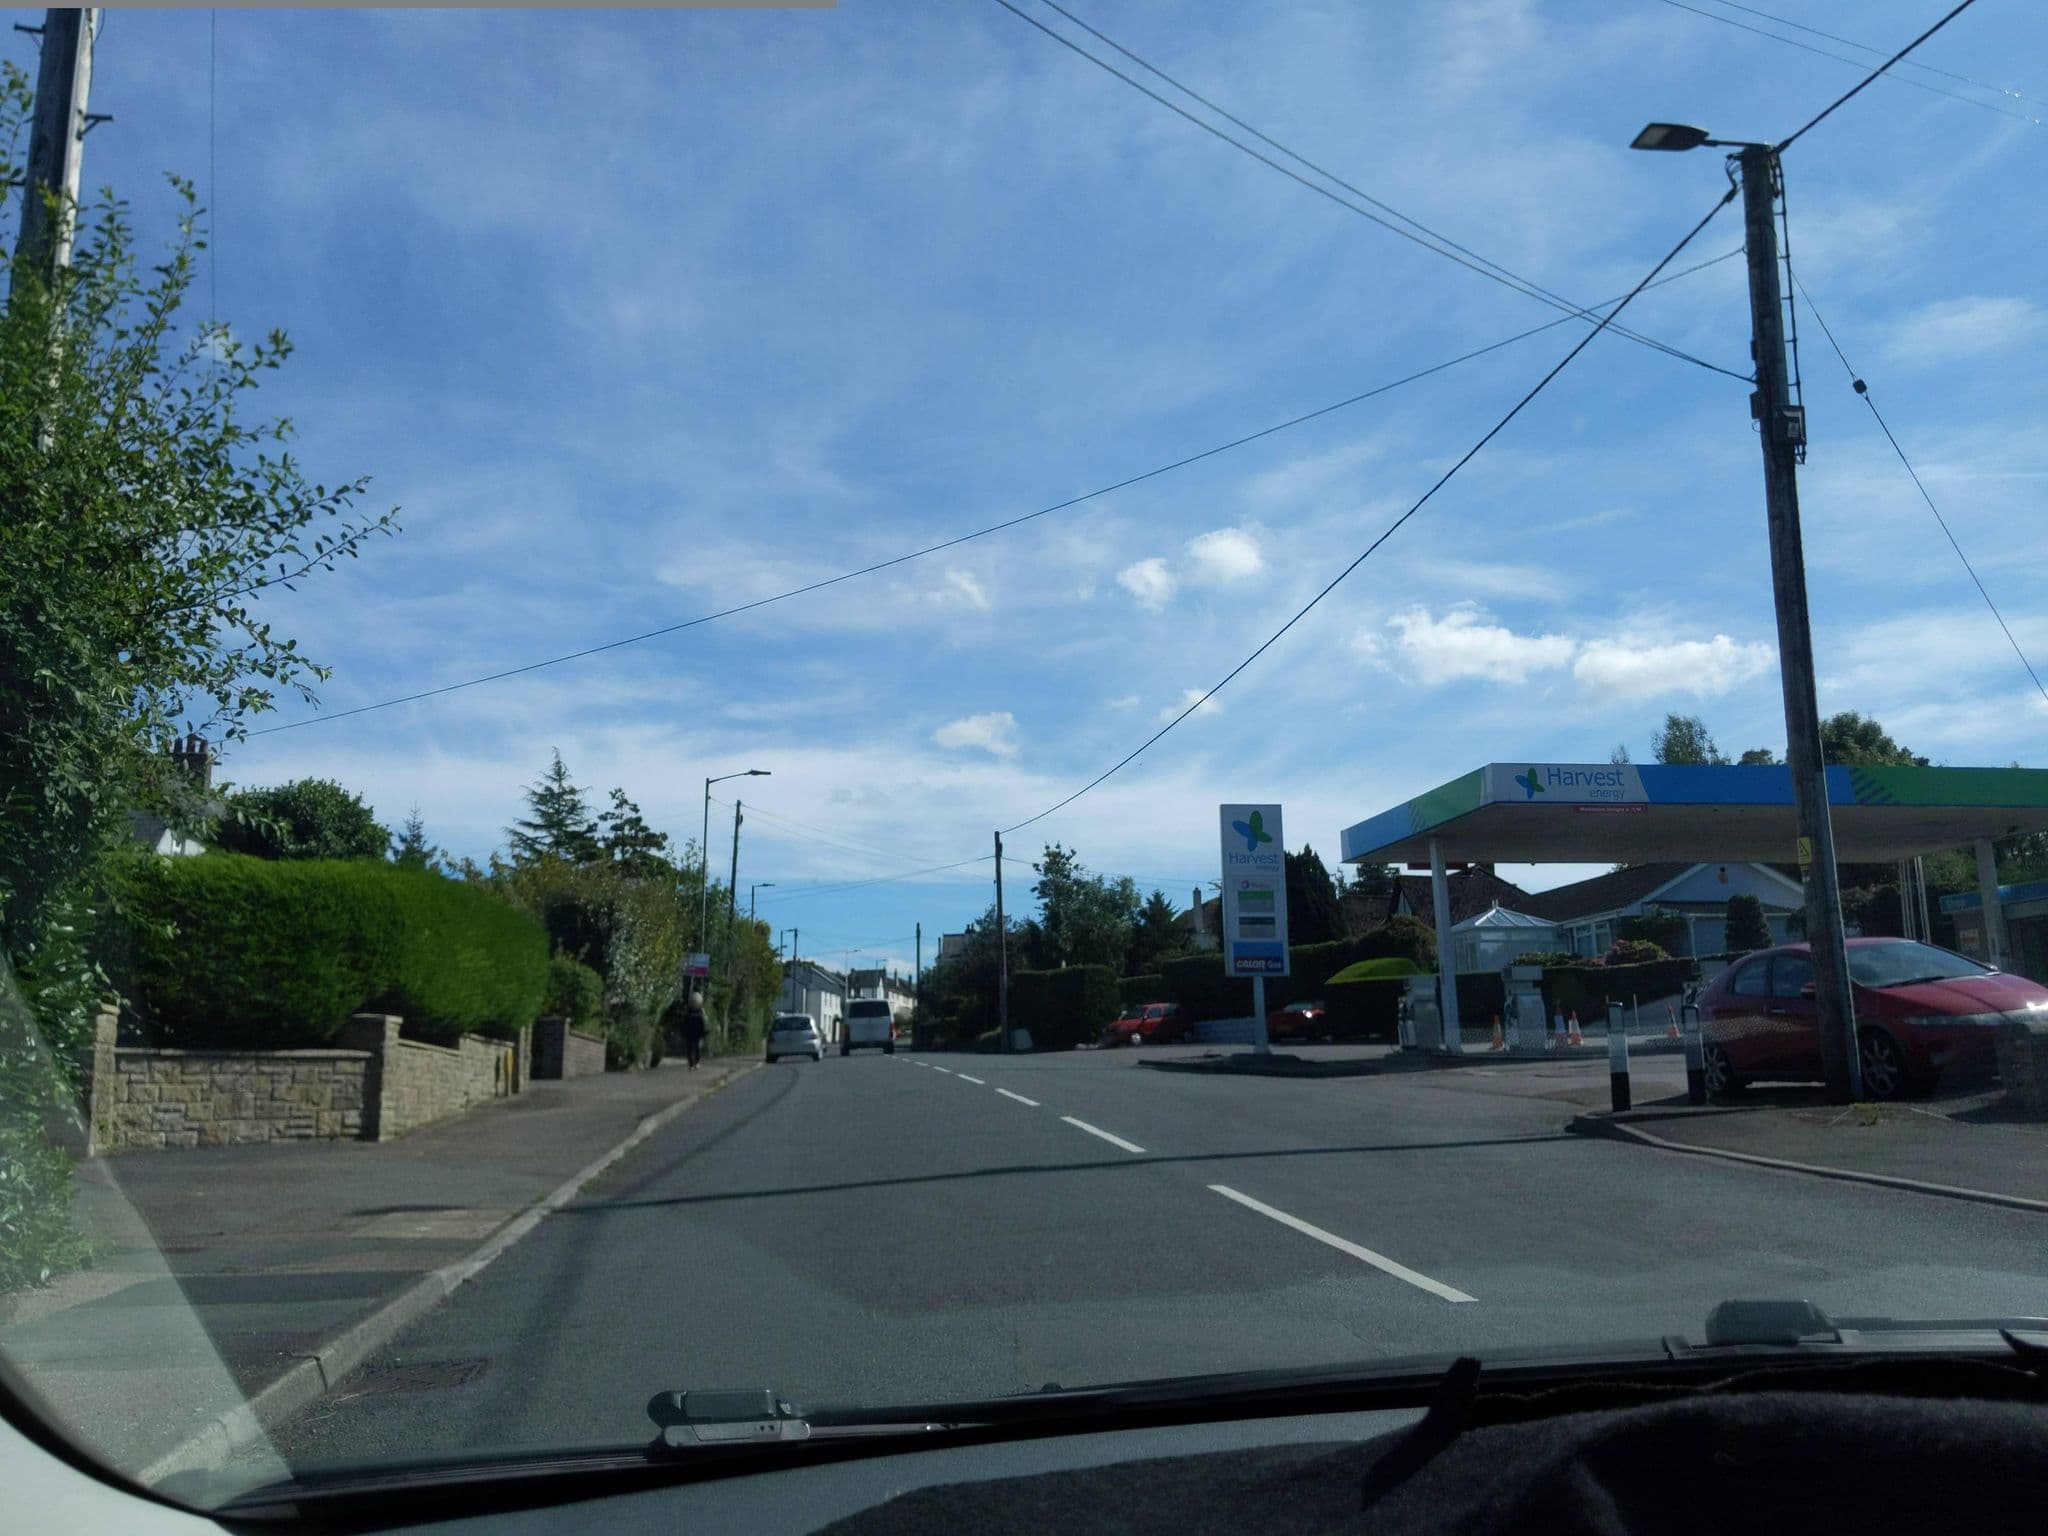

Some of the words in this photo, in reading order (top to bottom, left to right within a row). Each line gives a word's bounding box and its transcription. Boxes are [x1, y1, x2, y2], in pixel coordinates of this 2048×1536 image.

[1547, 767, 1625, 786] Harvest
[1590, 789, 1625, 800] energy
[1229, 851, 1280, 864] Harvest
[1236, 959, 1266, 969] CALOR
